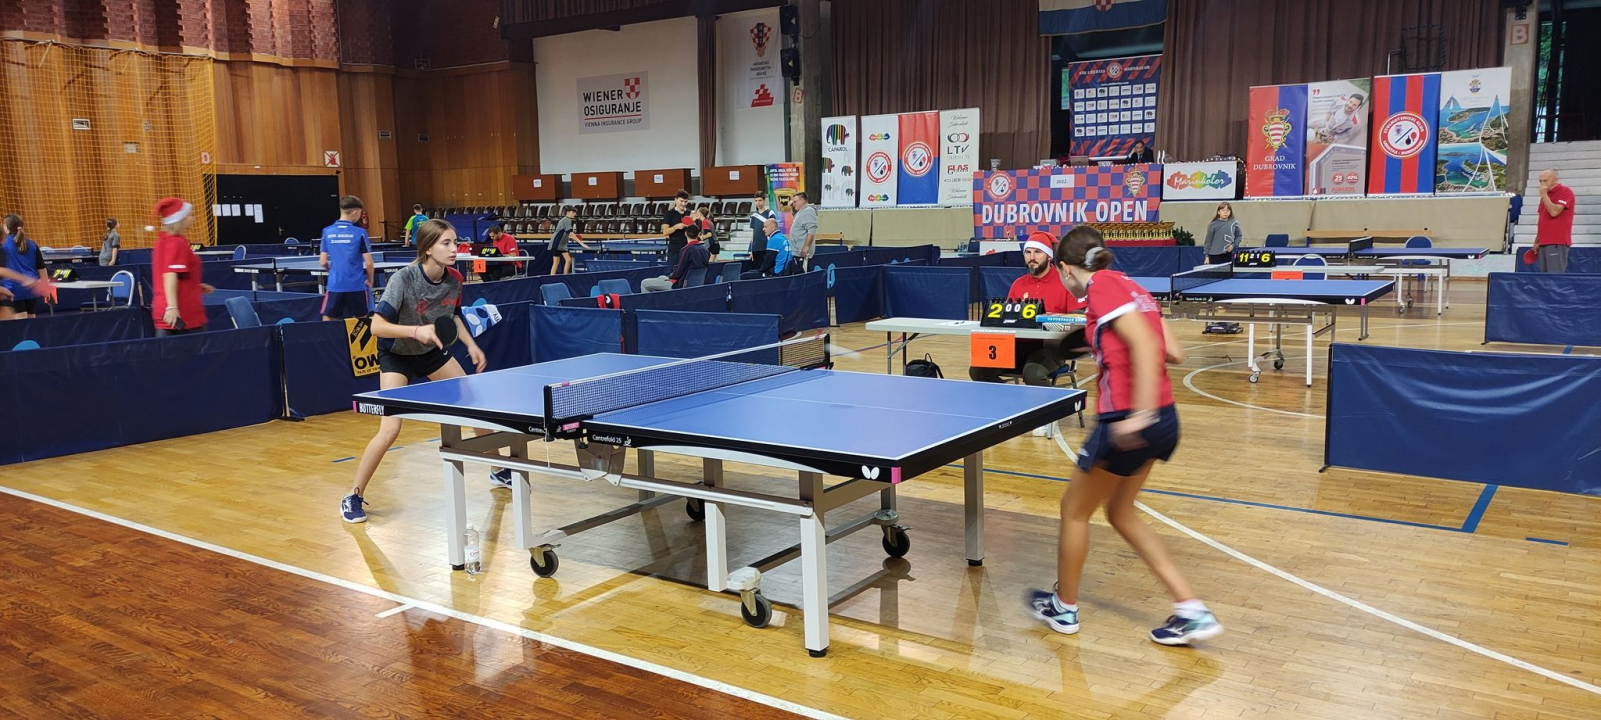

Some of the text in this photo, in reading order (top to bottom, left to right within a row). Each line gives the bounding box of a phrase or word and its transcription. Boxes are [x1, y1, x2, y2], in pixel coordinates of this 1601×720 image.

[1512, 25, 1527, 44] B
[583, 89, 624, 103] WIENER
[584, 101, 642, 116] OSIGURANJE
[947, 144, 970, 154] LTV
[1174, 175, 1225, 186] Marinkolor
[982, 200, 1148, 224] DUBROVNIK OPEN
[1240, 253, 1249, 262] 11
[1261, 253, 1270, 262] 6
[988, 304, 1036, 318] 2 0 0 6
[988, 345, 996, 360] 3
[359, 402, 384, 416] BUTTERFLY
[592, 434, 616, 443] Centrefold
